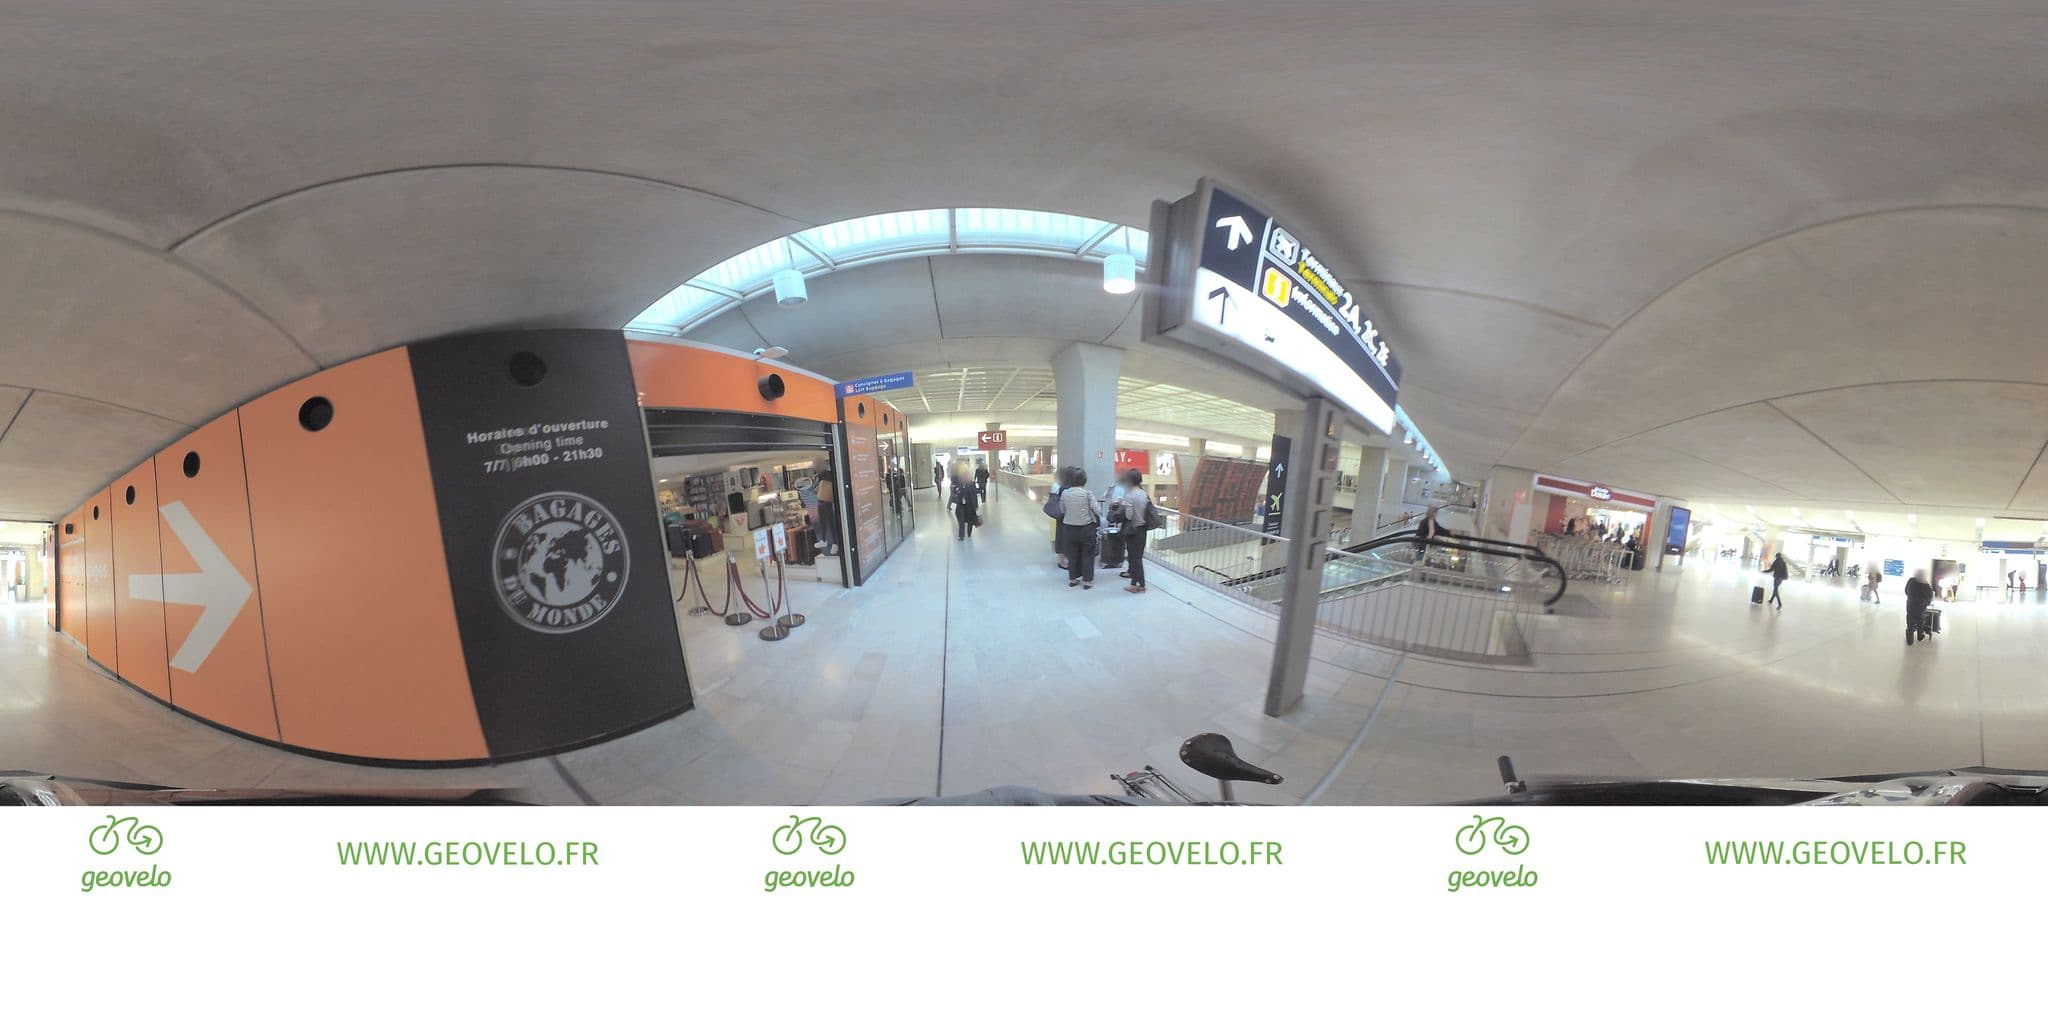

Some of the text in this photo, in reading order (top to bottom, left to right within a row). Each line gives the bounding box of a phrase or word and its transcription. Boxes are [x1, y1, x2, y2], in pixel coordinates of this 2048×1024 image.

[1291, 286, 1340, 335] Information
[528, 419, 609, 436] d'ouverture
[555, 435, 584, 448] time
[563, 447, 603, 462] 21h30
[514, 499, 620, 555] BAGAGES
[504, 576, 607, 626] DU MONDE
